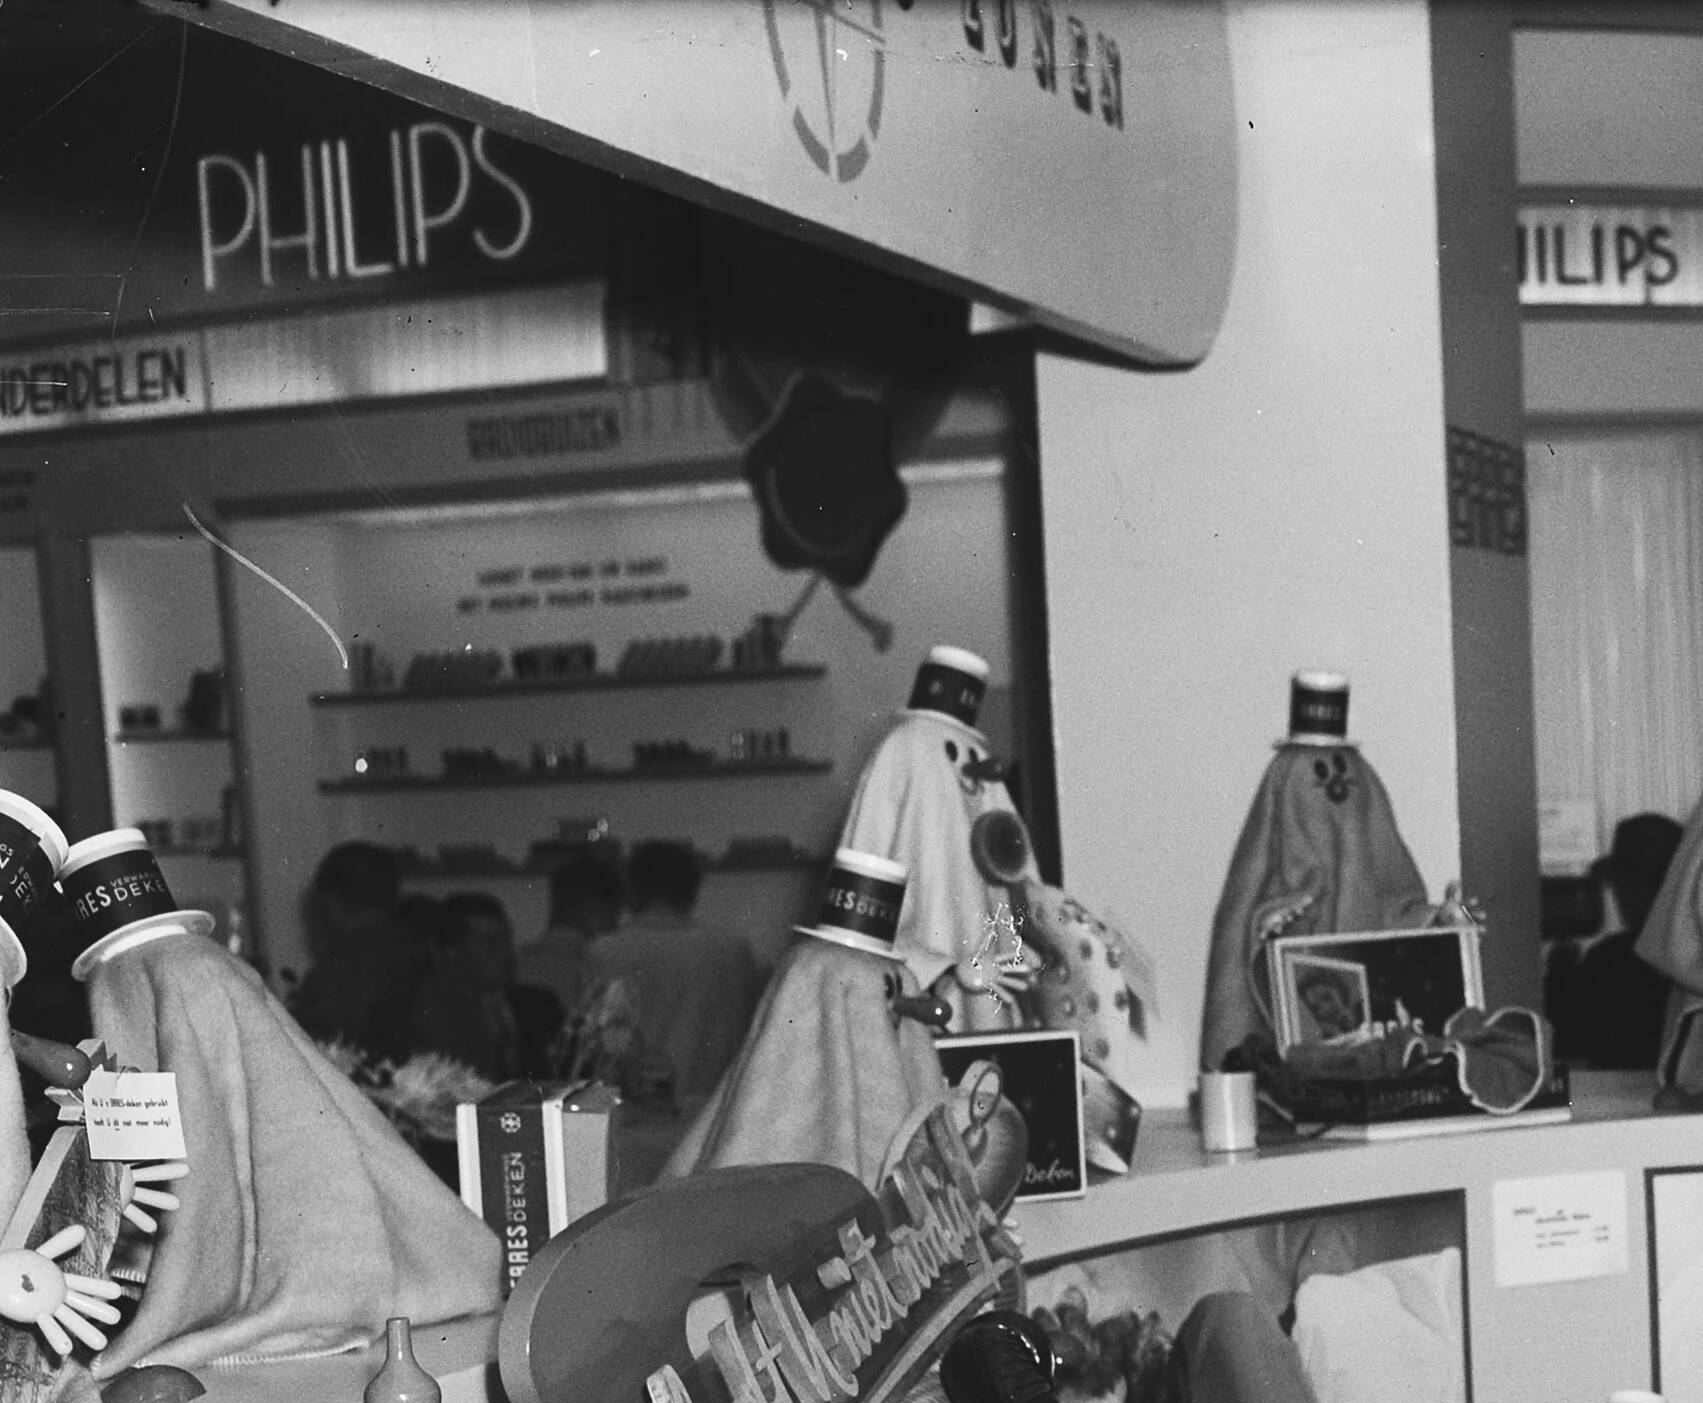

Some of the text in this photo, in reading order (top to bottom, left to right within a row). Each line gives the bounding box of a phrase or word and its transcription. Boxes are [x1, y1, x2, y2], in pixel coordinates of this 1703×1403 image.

[199, 122, 532, 291] PHILIPS
[506, 1152, 529, 1289] RRES DEKEN
[815, 1218, 909, 1371] niet
